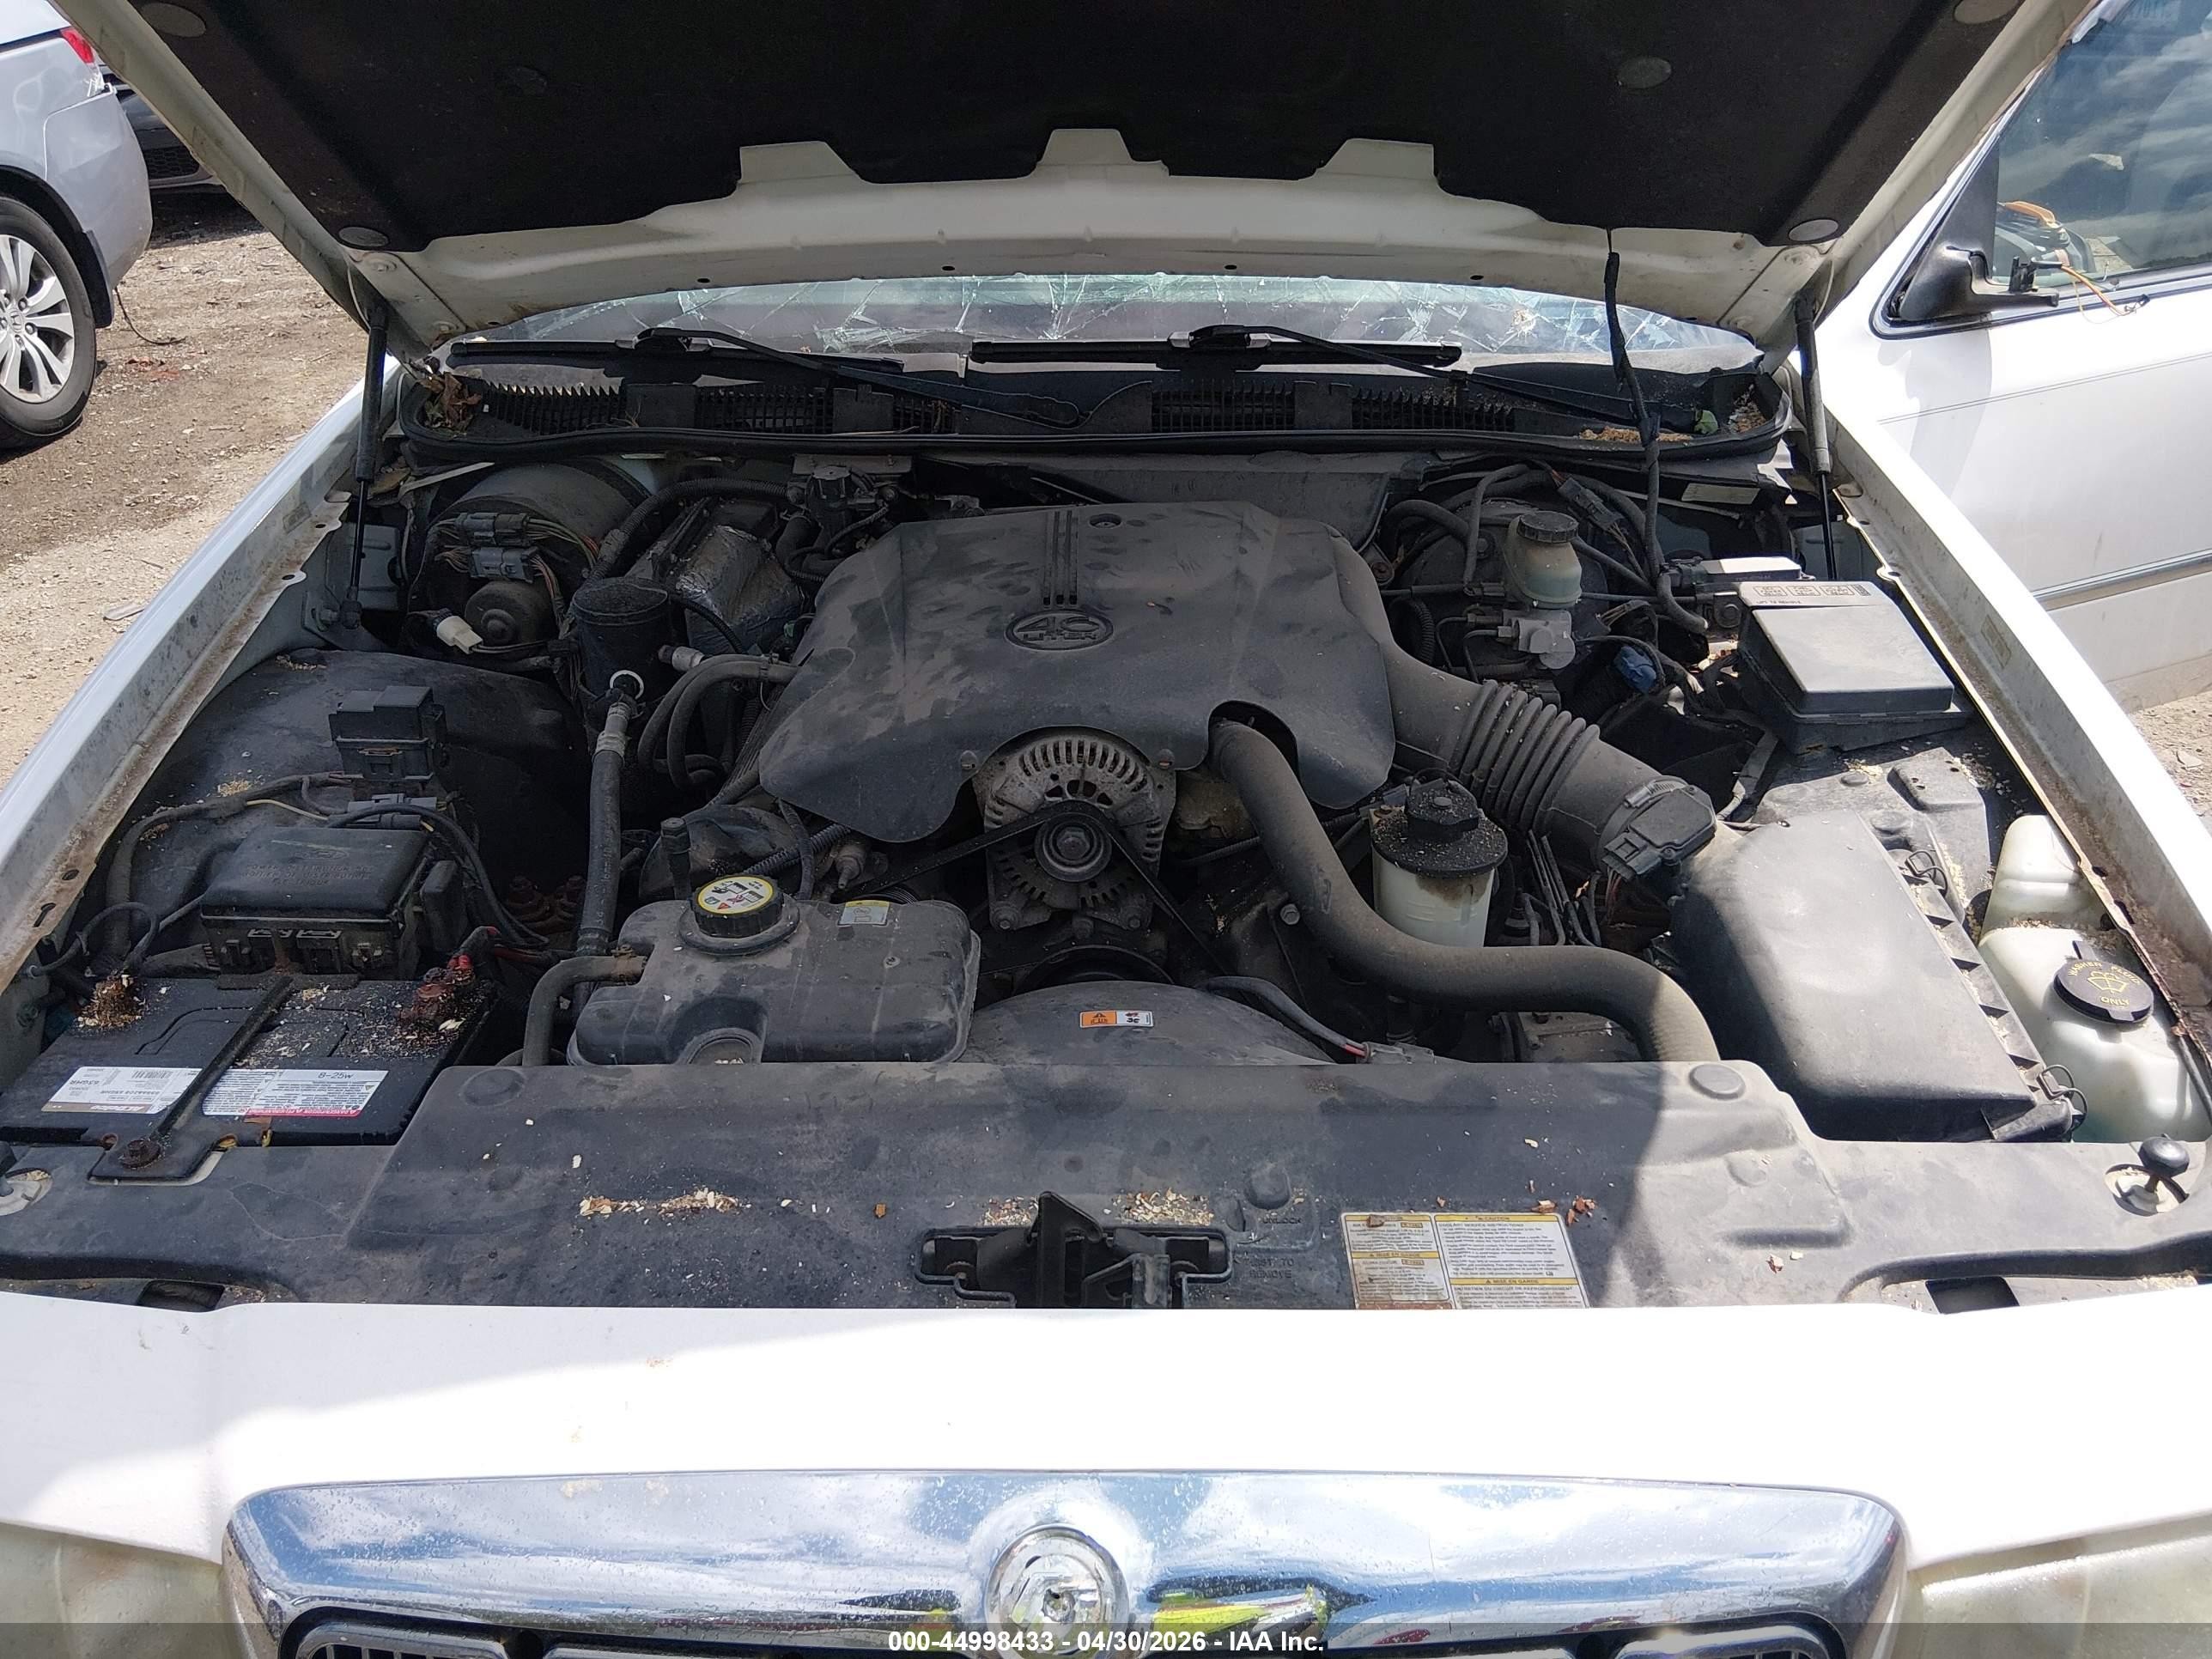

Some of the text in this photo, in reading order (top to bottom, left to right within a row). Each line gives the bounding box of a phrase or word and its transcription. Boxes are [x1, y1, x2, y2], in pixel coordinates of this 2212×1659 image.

[2068, 962, 2102, 975] WASHER
[2111, 966, 2140, 985] FLUID
[2100, 996, 2130, 1006] ONLY
[1249, 1269, 1292, 1279] REMOVE
